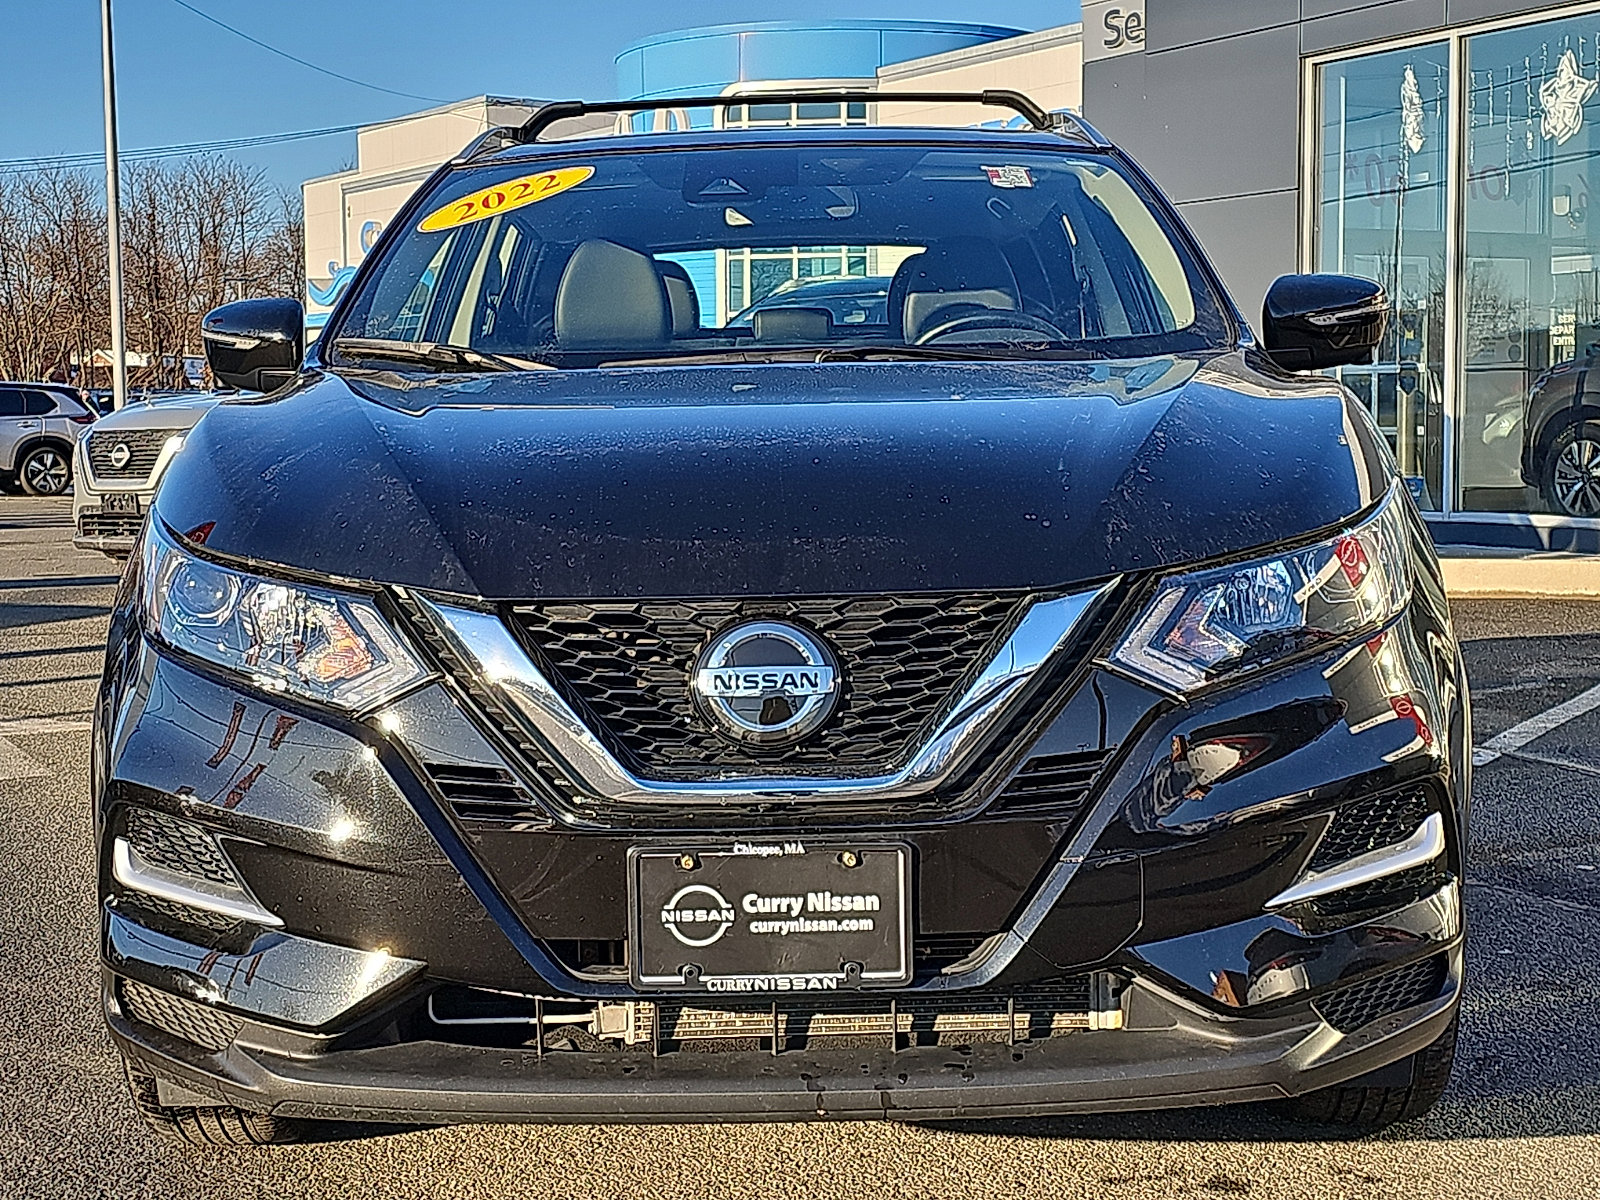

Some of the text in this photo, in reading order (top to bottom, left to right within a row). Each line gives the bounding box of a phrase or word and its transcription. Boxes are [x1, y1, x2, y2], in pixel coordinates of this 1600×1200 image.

[1104, 9, 1142, 46] Se
[453, 174, 561, 223] 2022
[713, 671, 820, 691] NISSAN
[784, 840, 806, 855] MA
[742, 891, 880, 917] Curry Nissan
[661, 909, 735, 923] NISSAN
[749, 917, 874, 936] currynissan.com
